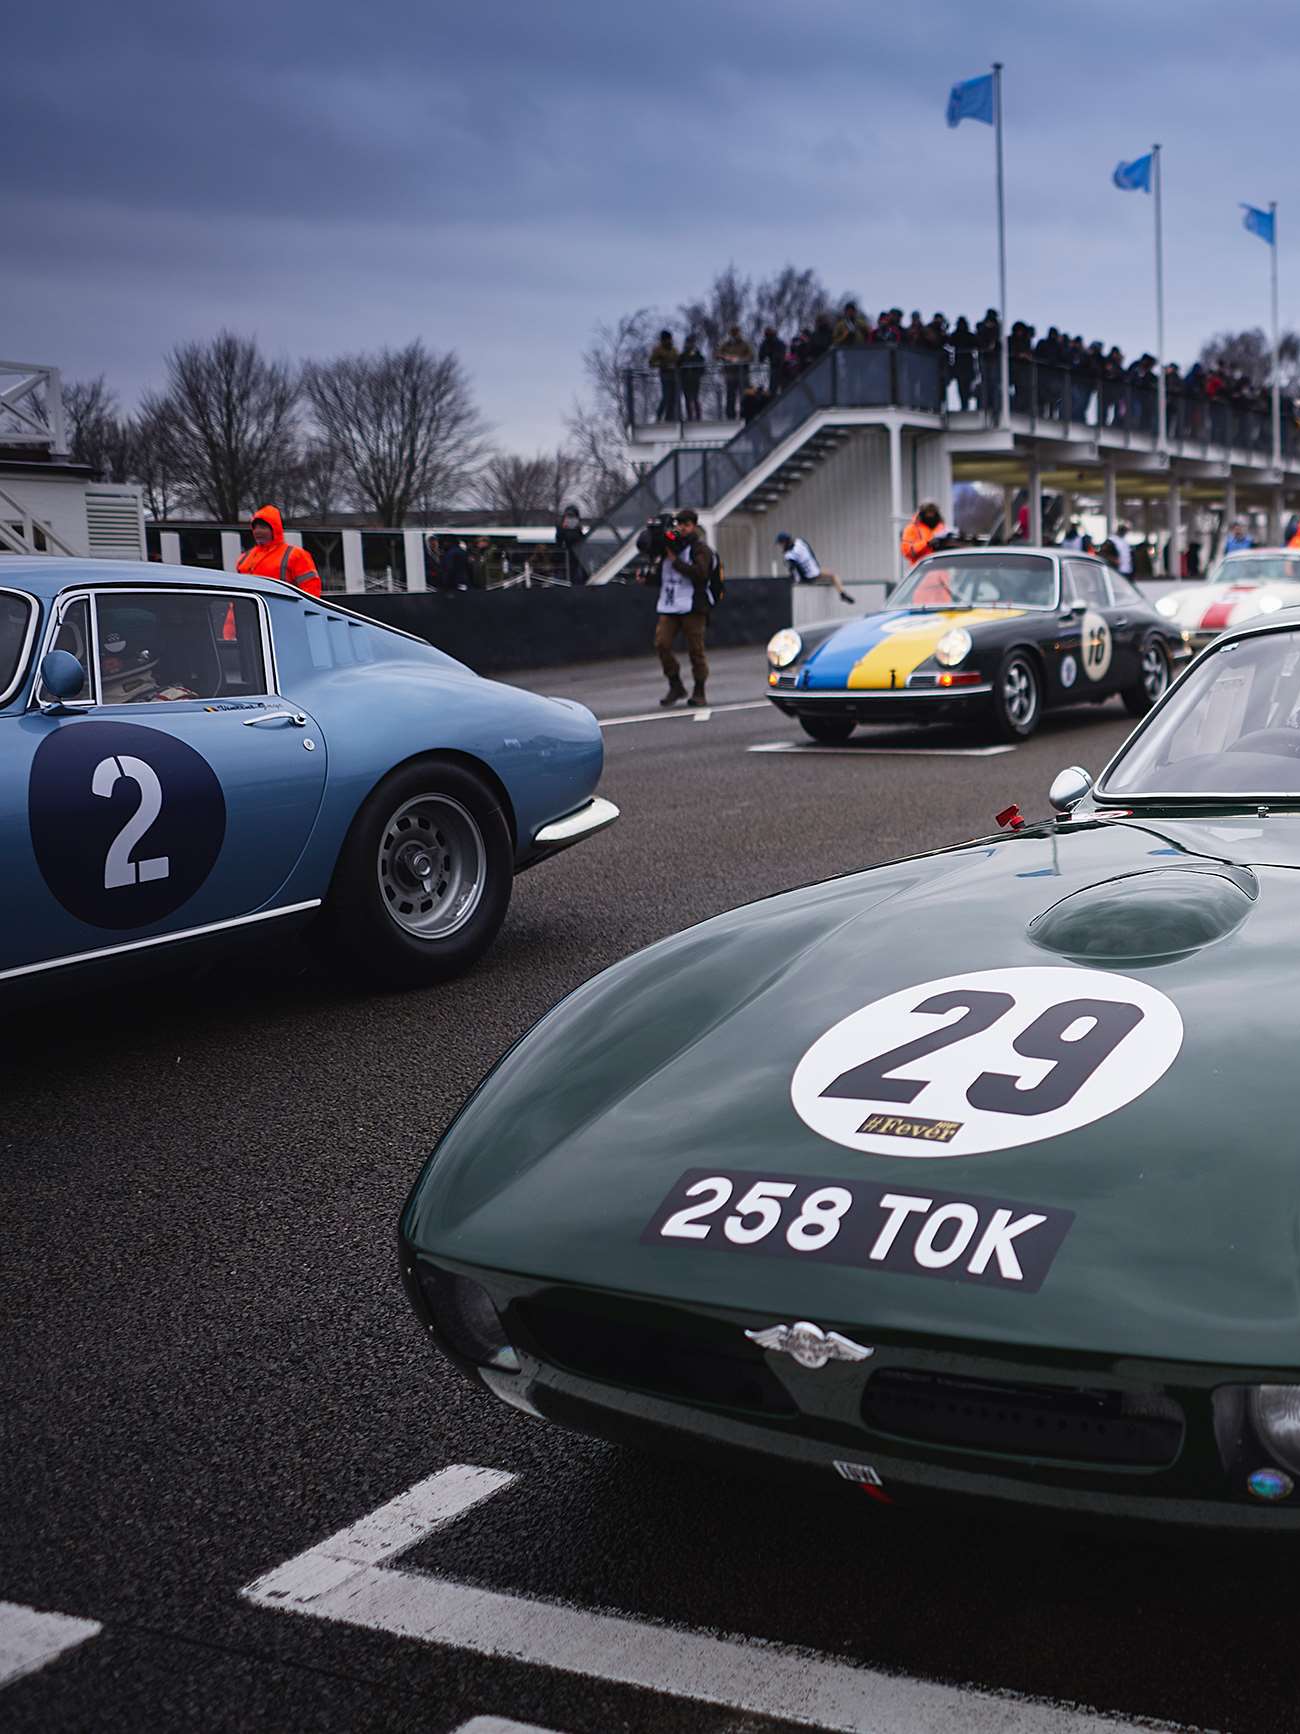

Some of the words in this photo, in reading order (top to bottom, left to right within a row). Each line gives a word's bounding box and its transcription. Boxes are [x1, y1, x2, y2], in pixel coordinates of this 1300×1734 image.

[92, 755, 169, 889] 2
[817, 989, 1145, 1116] 29
[863, 1117, 956, 1140] #Fever
[660, 1176, 853, 1251] 258
[869, 1193, 1048, 1280] TOK
